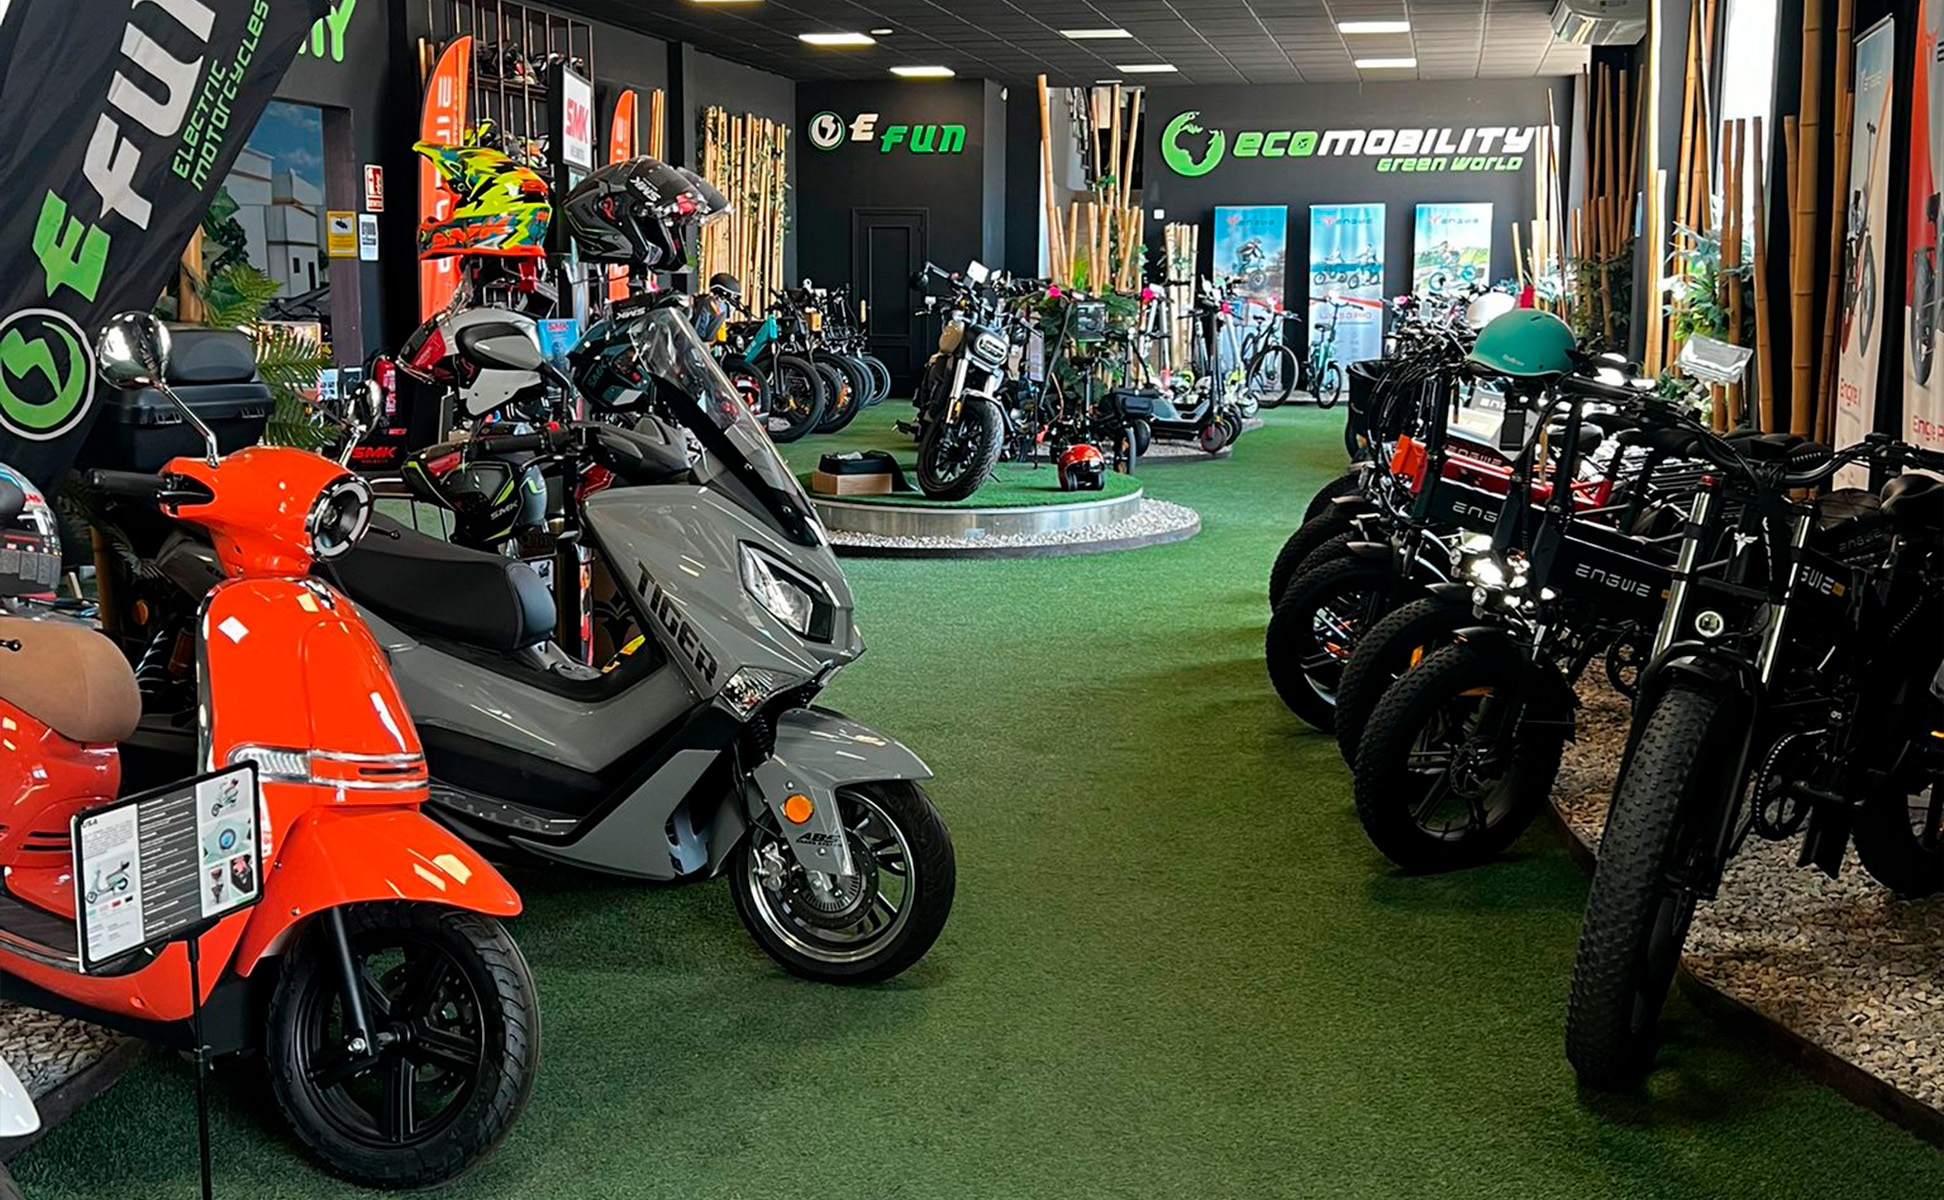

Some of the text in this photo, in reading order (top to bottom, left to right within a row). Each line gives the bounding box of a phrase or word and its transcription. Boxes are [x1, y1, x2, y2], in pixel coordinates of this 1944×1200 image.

[565, 97, 590, 145] SMK
[848, 113, 966, 152] E FUN
[351, 445, 397, 460] SMK
[1447, 444, 1503, 467] ENGWE
[490, 499, 519, 521] SMK
[1452, 500, 1499, 523] ENG
[1574, 562, 1652, 598] ENGWE
[637, 559, 719, 688] TIGER
[797, 831, 842, 843] ABS
